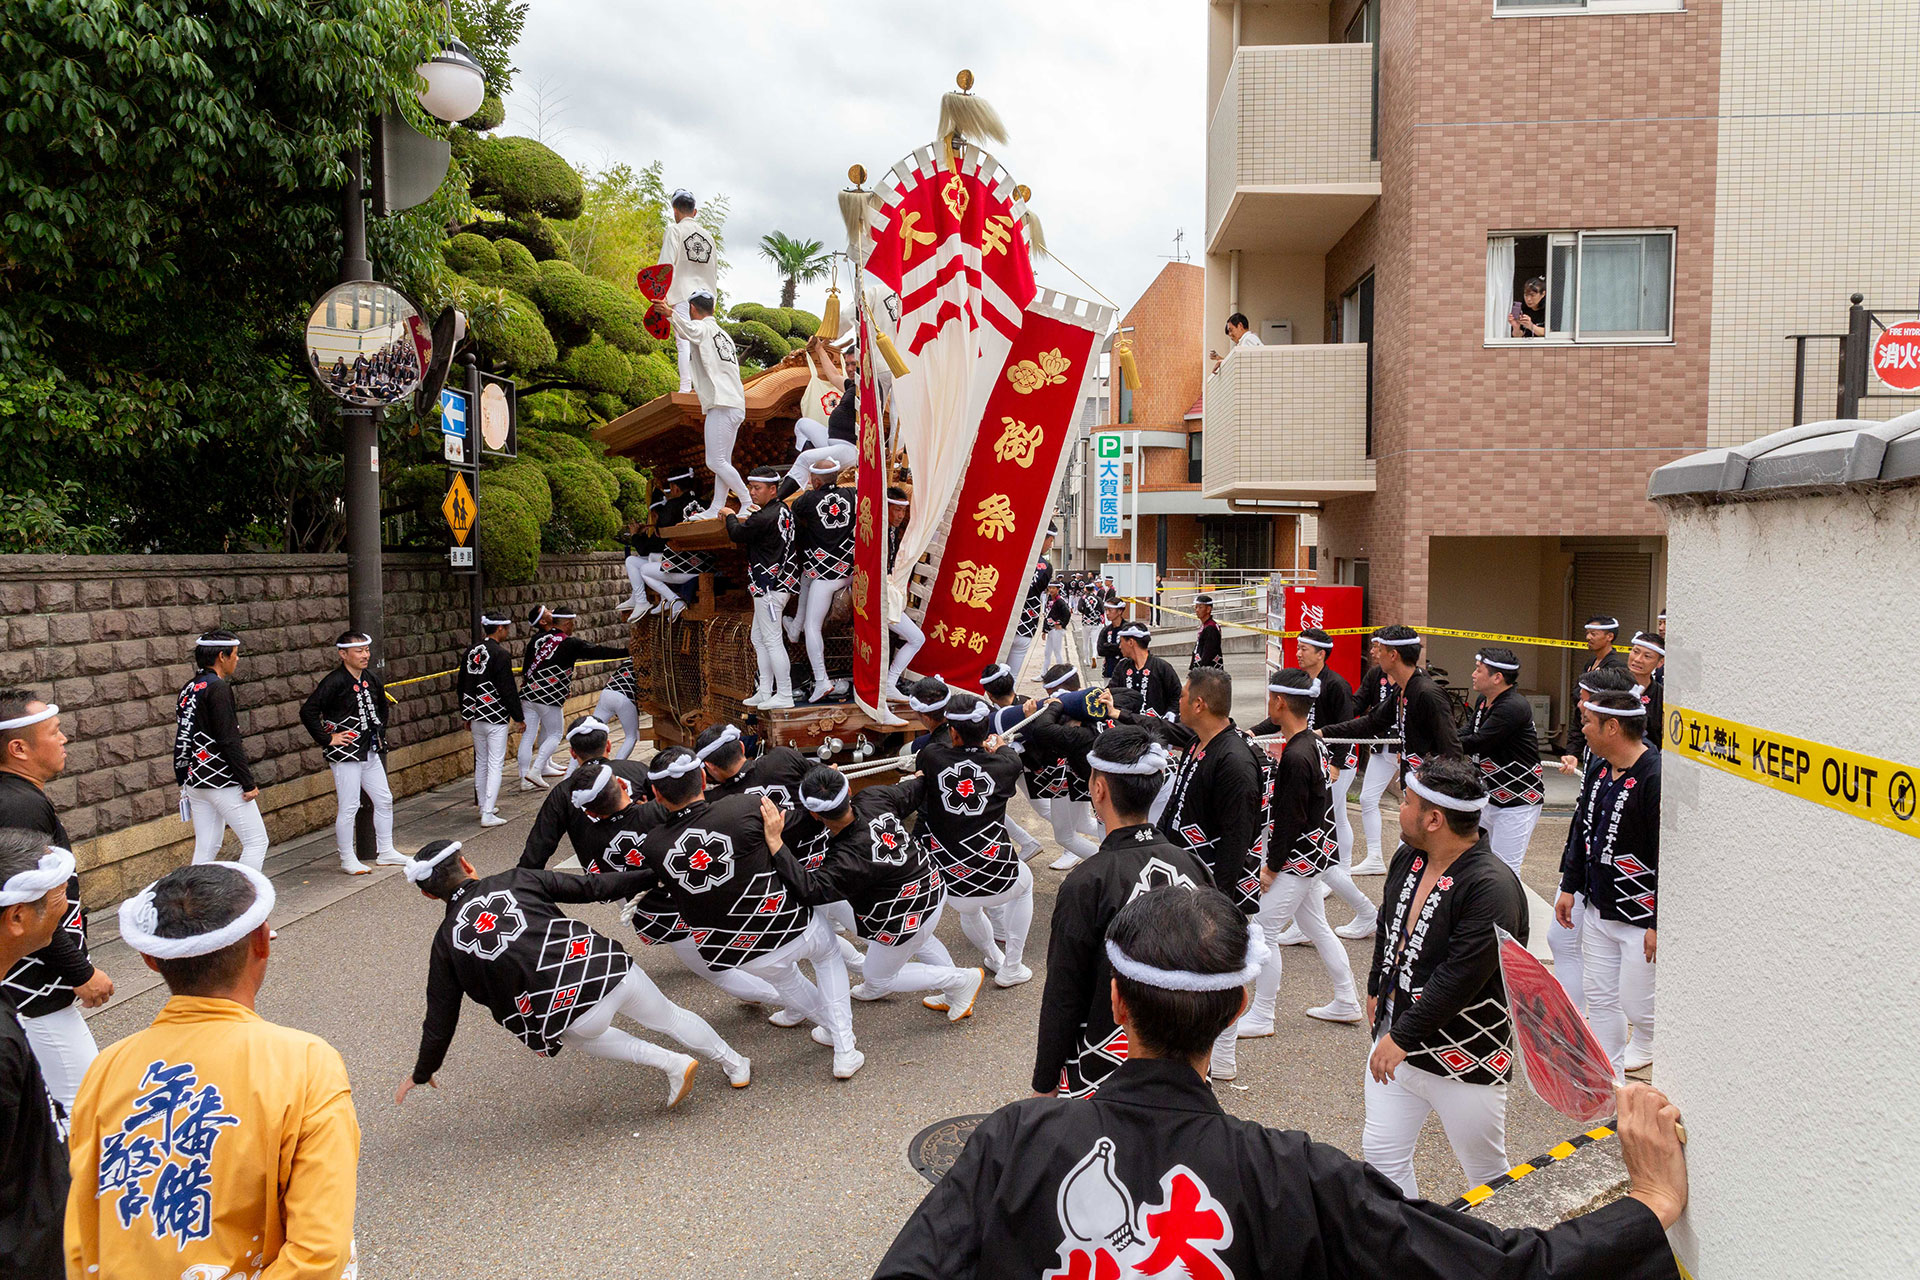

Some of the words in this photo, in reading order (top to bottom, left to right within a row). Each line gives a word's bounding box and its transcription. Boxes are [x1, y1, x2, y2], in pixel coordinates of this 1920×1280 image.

[899, 208, 1014, 261] 大手
[1889, 327, 1902, 336] FIRE
[1102, 438, 1118, 456] P
[1100, 460, 1119, 534] 大賀医院
[930, 620, 988, 654] 大手町
[1688, 720, 1741, 766] 立入禁止
[1752, 737, 1810, 785] KEEP
[1822, 757, 1878, 807] OUT
[956, 779, 976, 798] 手
